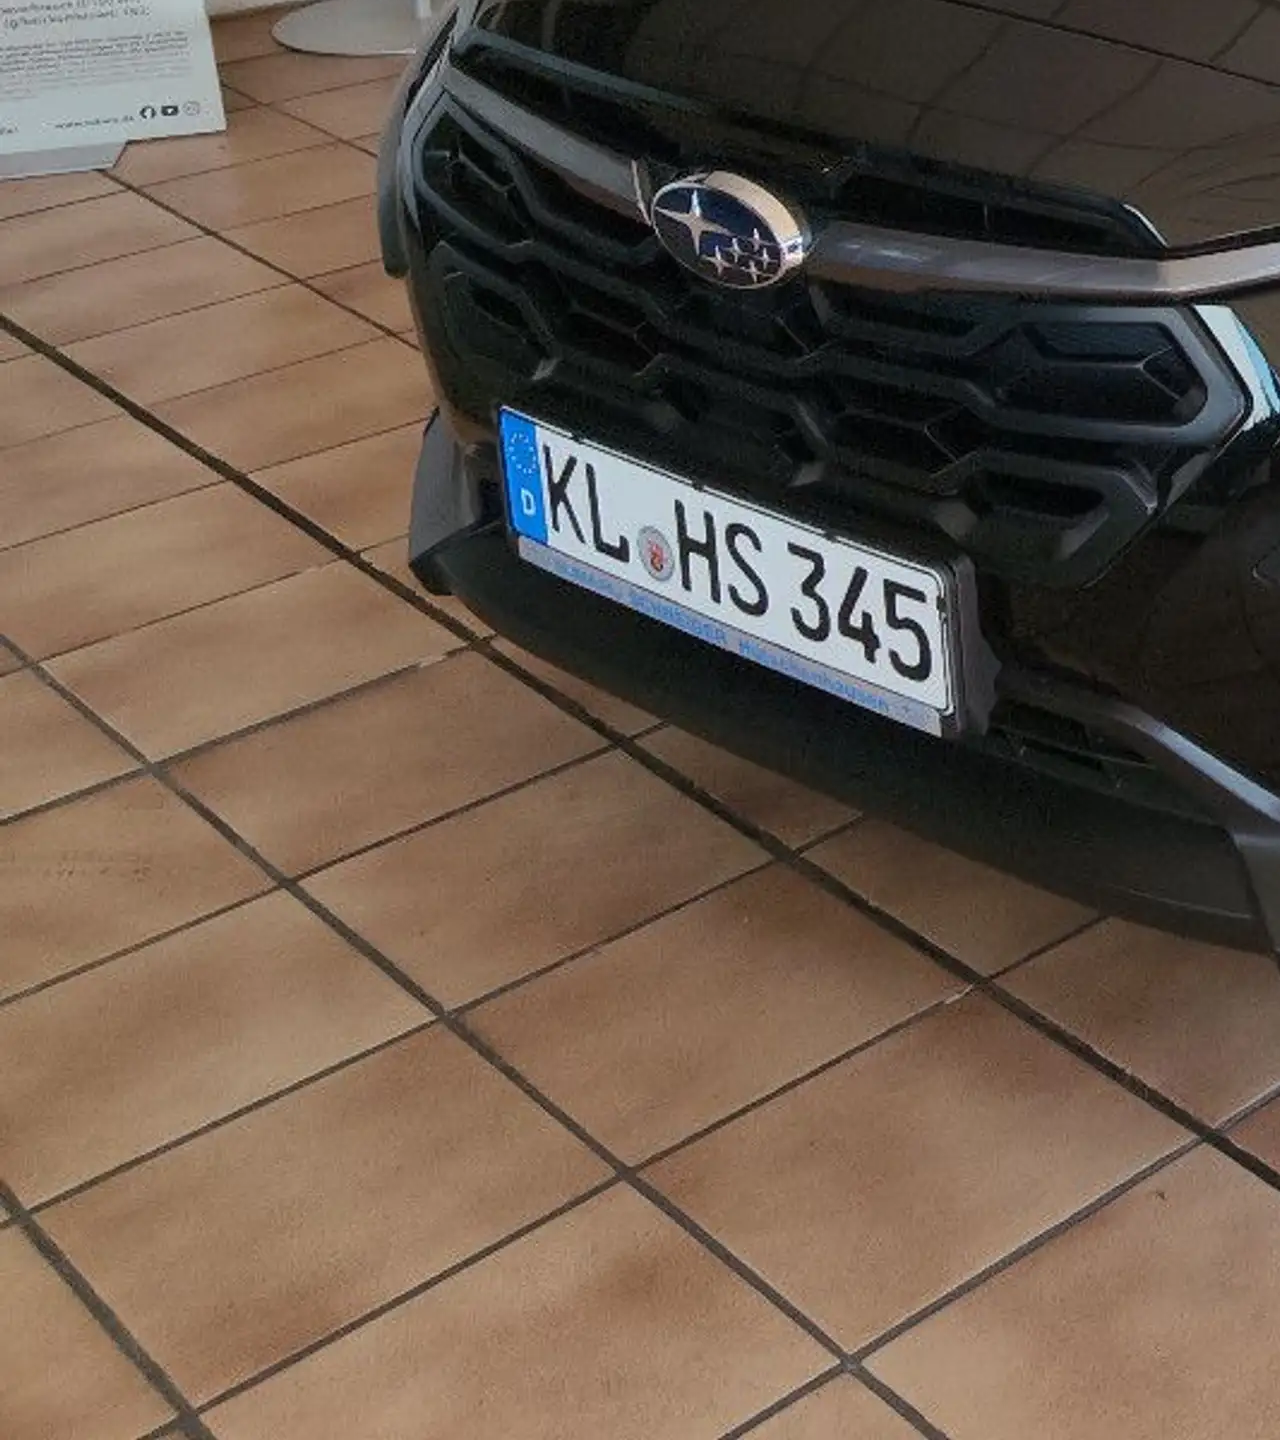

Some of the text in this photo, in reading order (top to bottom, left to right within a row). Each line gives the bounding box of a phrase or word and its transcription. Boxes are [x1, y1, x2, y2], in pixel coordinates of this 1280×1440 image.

[521, 486, 537, 517] D
[543, 443, 932, 682] KL HS 345
